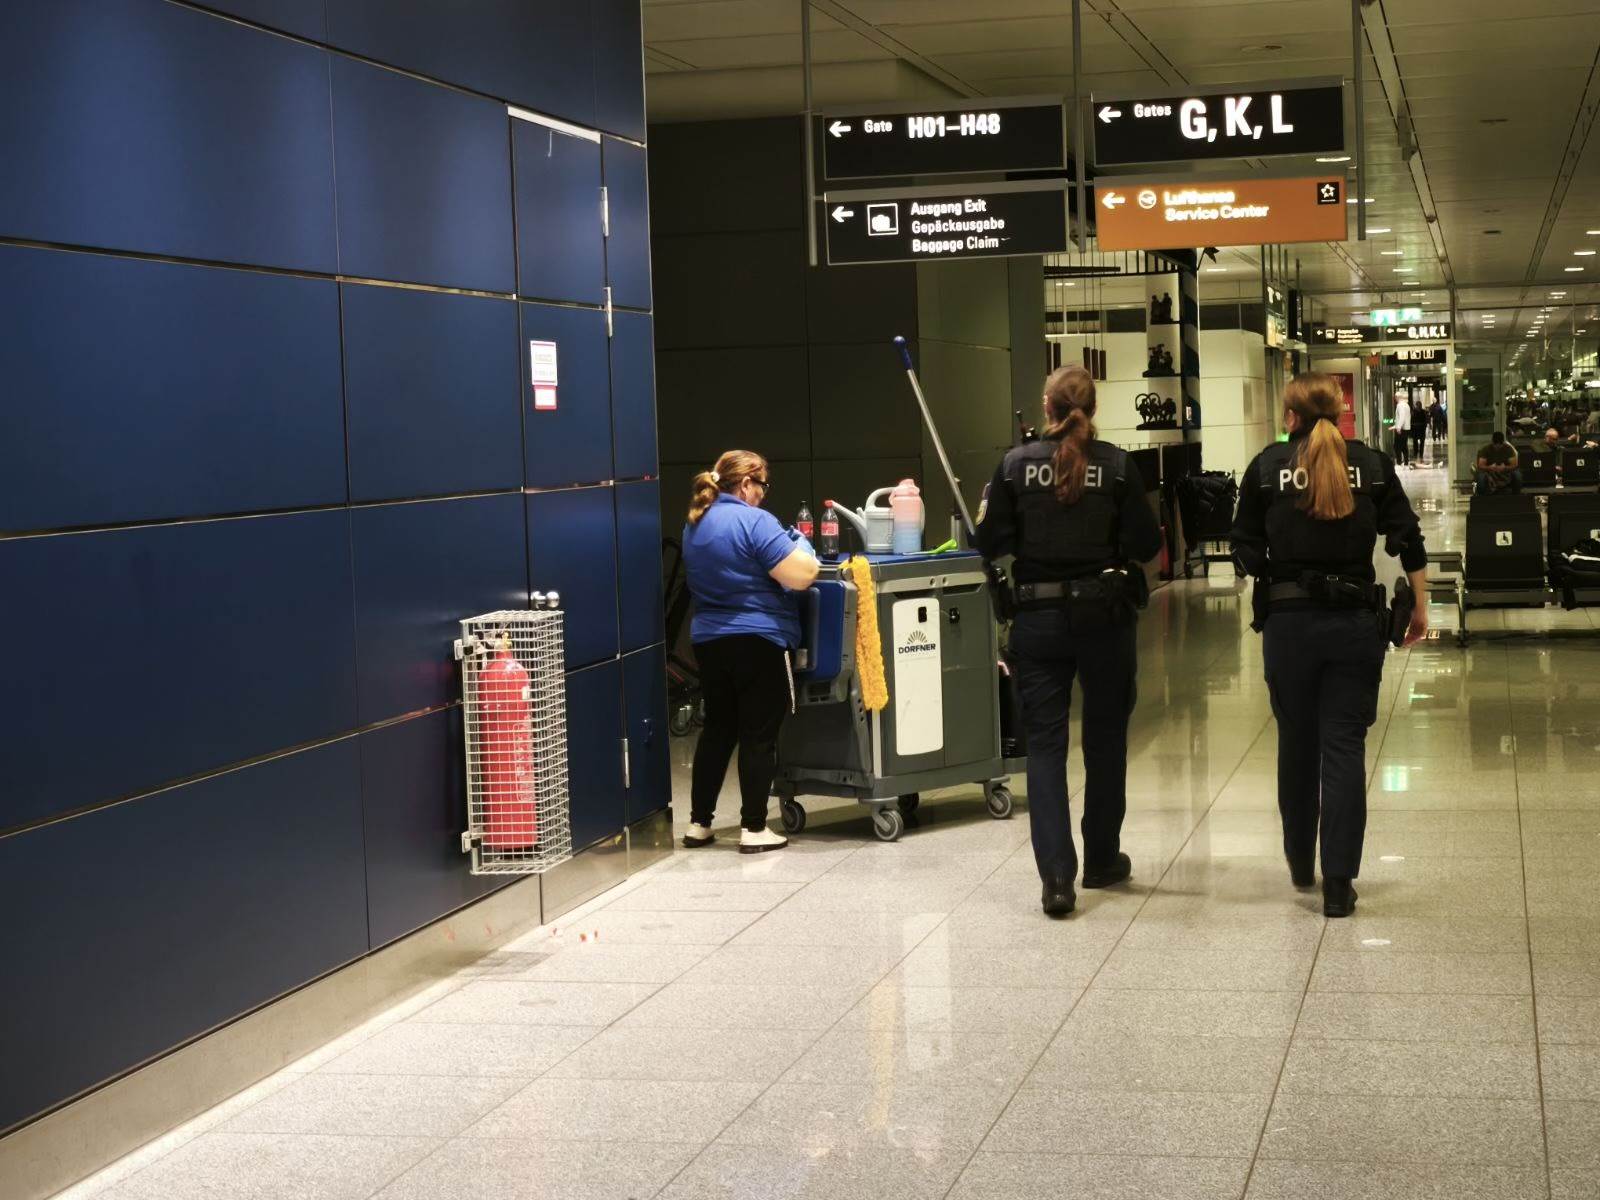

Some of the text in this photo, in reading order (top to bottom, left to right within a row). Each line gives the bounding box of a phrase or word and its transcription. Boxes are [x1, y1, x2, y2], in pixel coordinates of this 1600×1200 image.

[1134, 104, 1172, 118] Gates
[1270, 95, 1294, 133] L
[864, 120, 893, 134] Gate
[911, 199, 987, 217] Ausgang Exit
[1164, 205, 1270, 222] Service Center
[911, 217, 1005, 235] Gepäckausgabe
[912, 235, 999, 253] Baggage Claim
[898, 643, 936, 654] DORFNER
